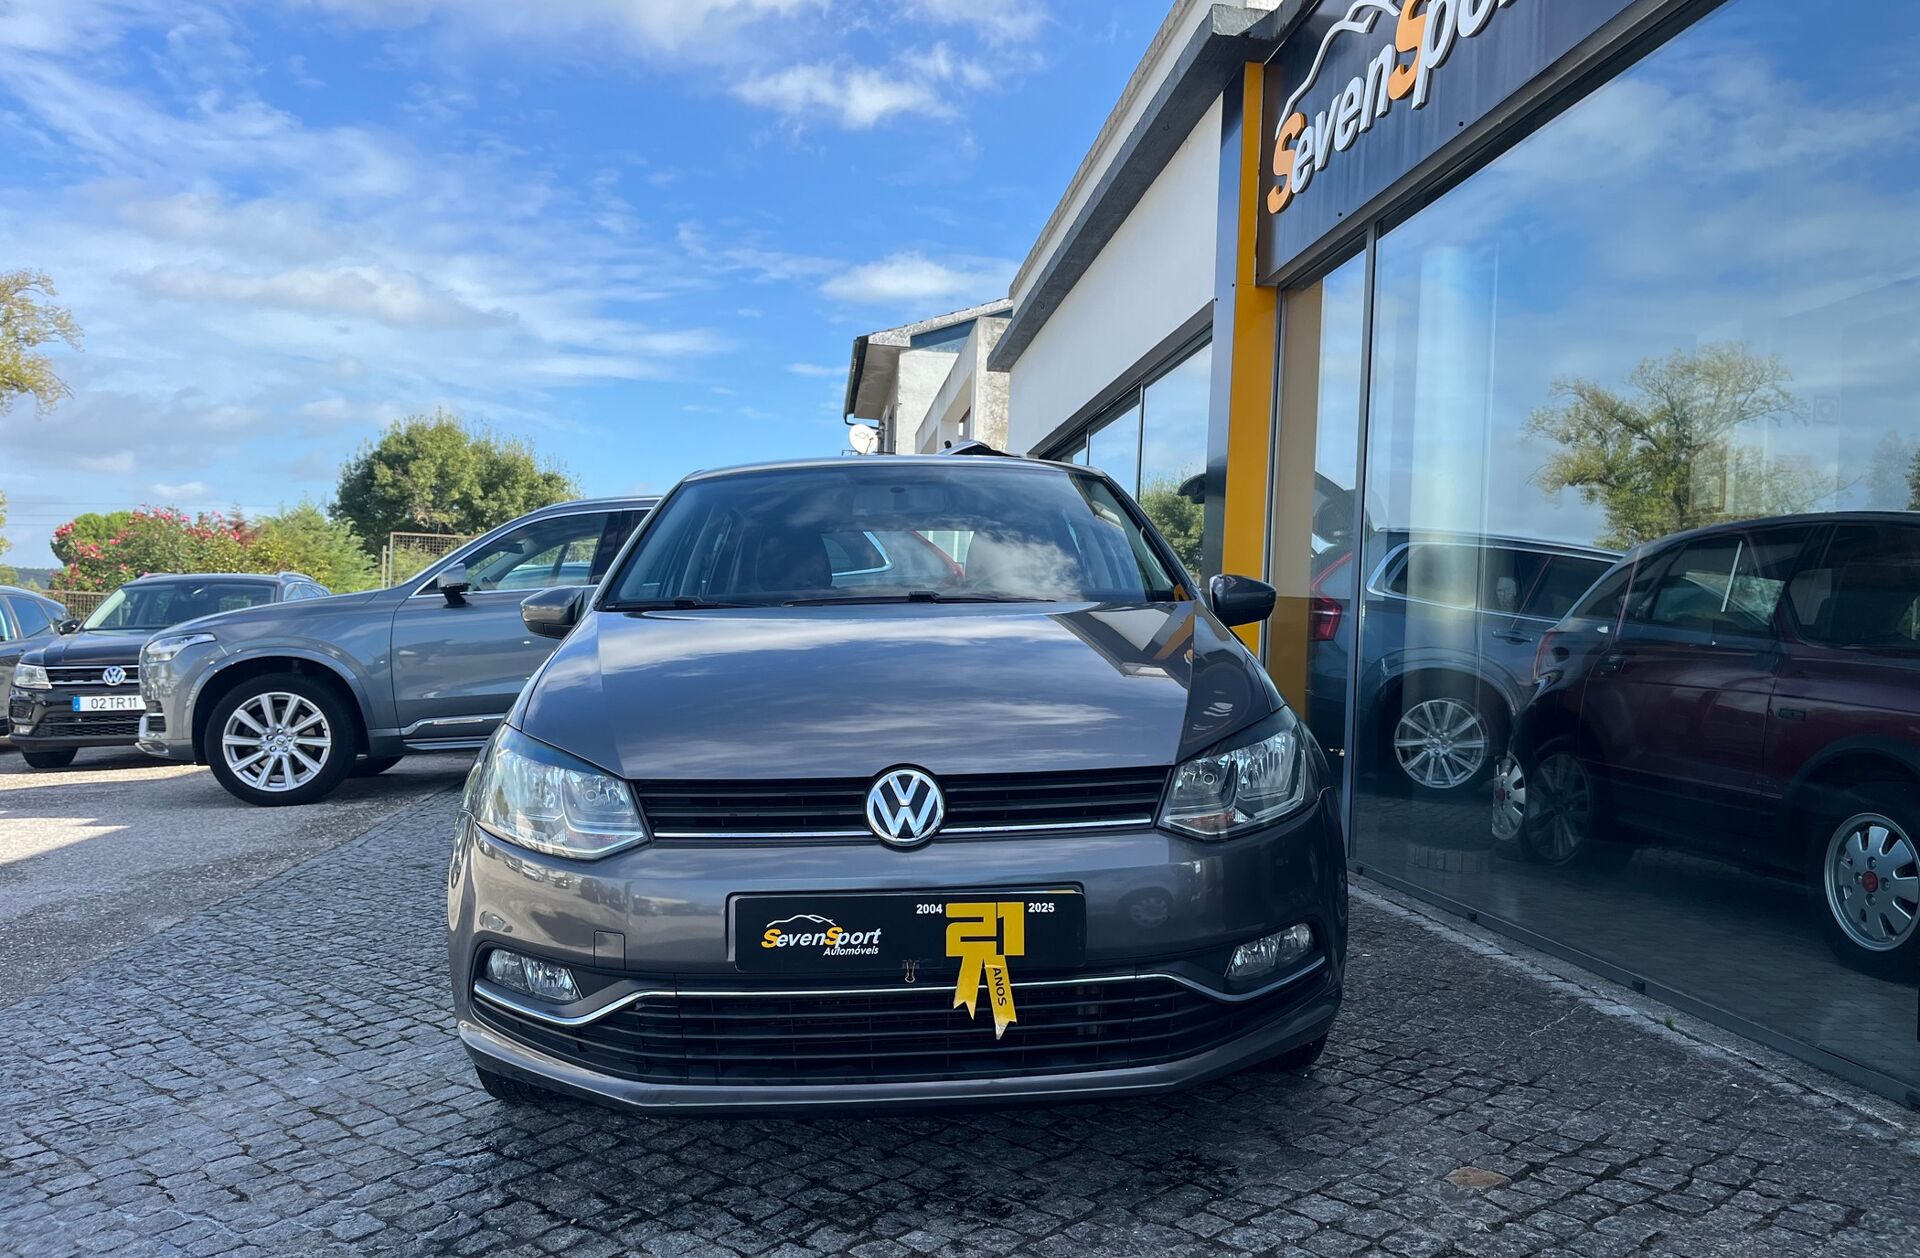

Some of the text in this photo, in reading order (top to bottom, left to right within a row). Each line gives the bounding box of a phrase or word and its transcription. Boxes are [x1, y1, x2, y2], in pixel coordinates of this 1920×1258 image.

[1267, 0, 1508, 214] SevenSp
[868, 770, 943, 843] VW
[761, 926, 881, 948] SevenSport
[823, 945, 879, 956] Automóveis
[916, 902, 1055, 957] 2004 21 2025
[993, 967, 1007, 1006] ANOS
